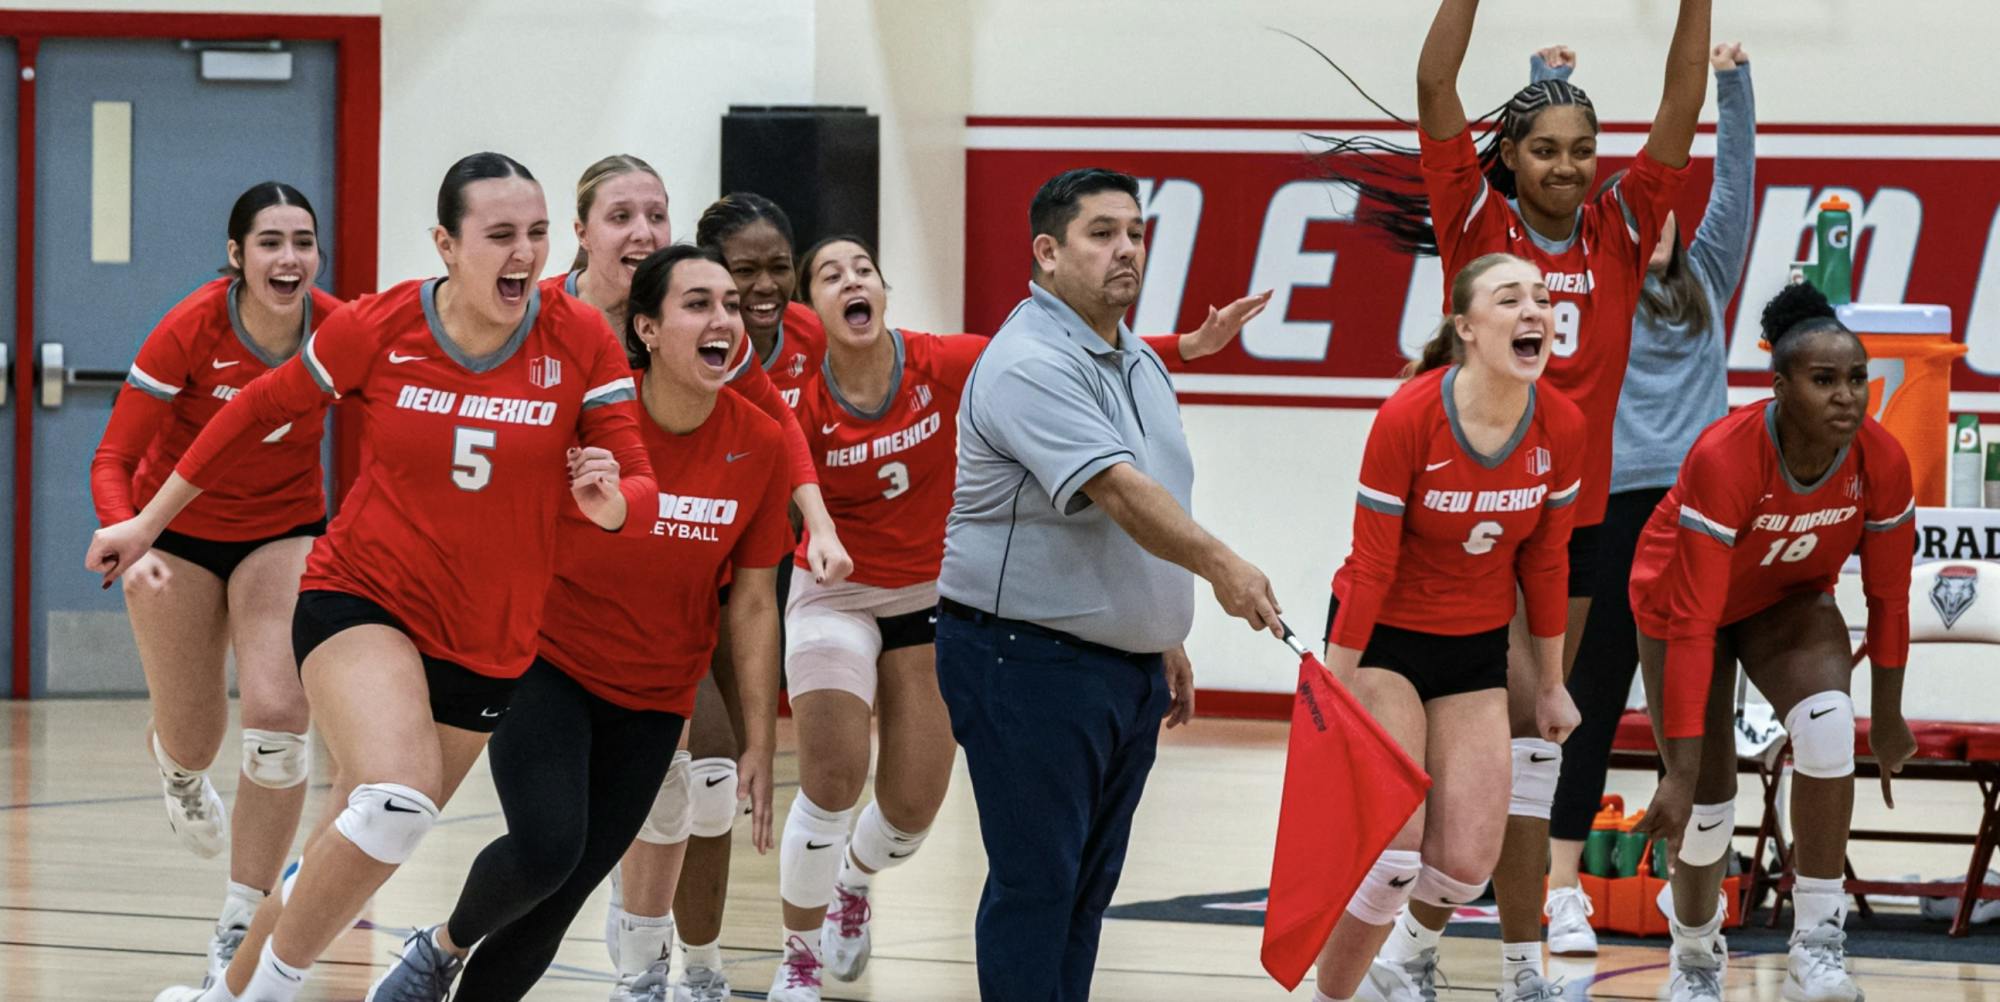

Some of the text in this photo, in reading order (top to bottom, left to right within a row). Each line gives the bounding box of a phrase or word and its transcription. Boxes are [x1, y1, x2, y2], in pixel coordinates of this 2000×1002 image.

[212, 385, 241, 401] NE
[396, 384, 557, 426] NEW MEXICO
[826, 411, 940, 467] NEW MEXICO
[451, 425, 497, 491] 5
[877, 461, 909, 500] 3
[1423, 489, 1473, 513] NEW
[650, 521, 719, 541] EYBALL
[1461, 521, 1504, 555] 6
[1914, 526, 2000, 559] RAD
[1760, 533, 1818, 566] 18
